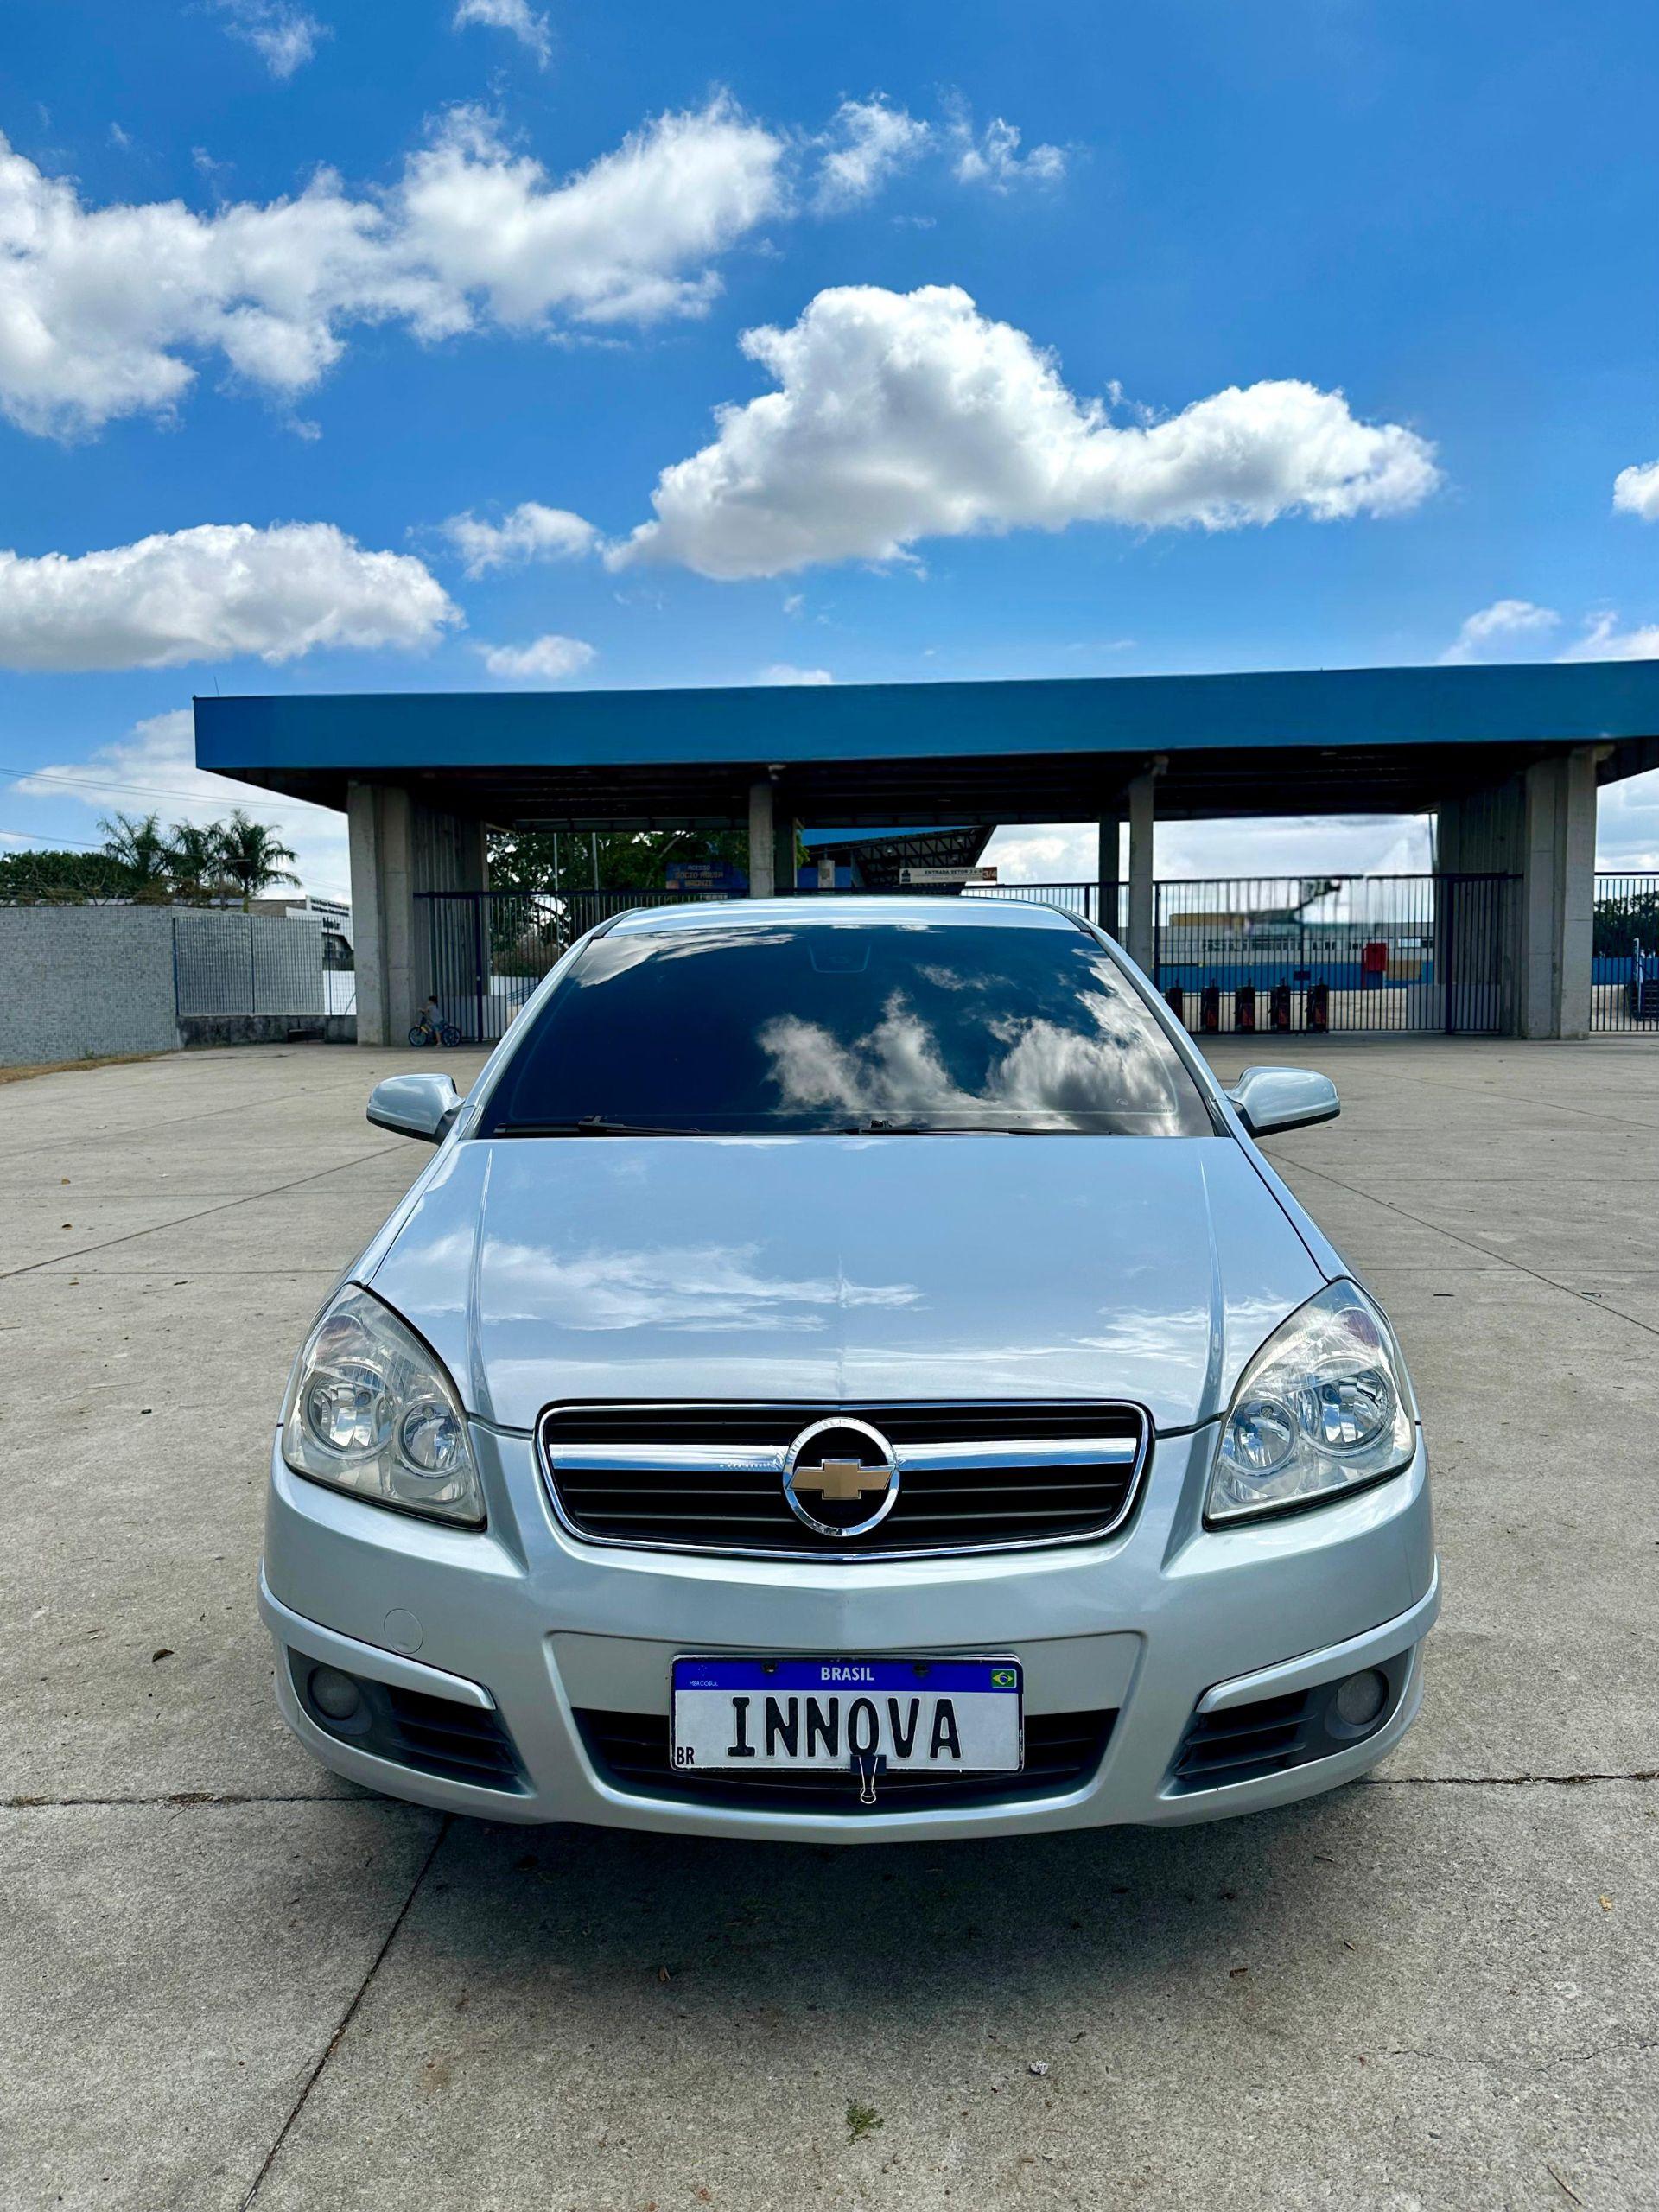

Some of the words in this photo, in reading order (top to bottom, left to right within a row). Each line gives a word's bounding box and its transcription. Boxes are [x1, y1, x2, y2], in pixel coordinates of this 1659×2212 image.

[821, 1667, 874, 1681] BRASIL
[728, 1696, 963, 1759] INNOVA
[676, 1746, 695, 1765] BR
